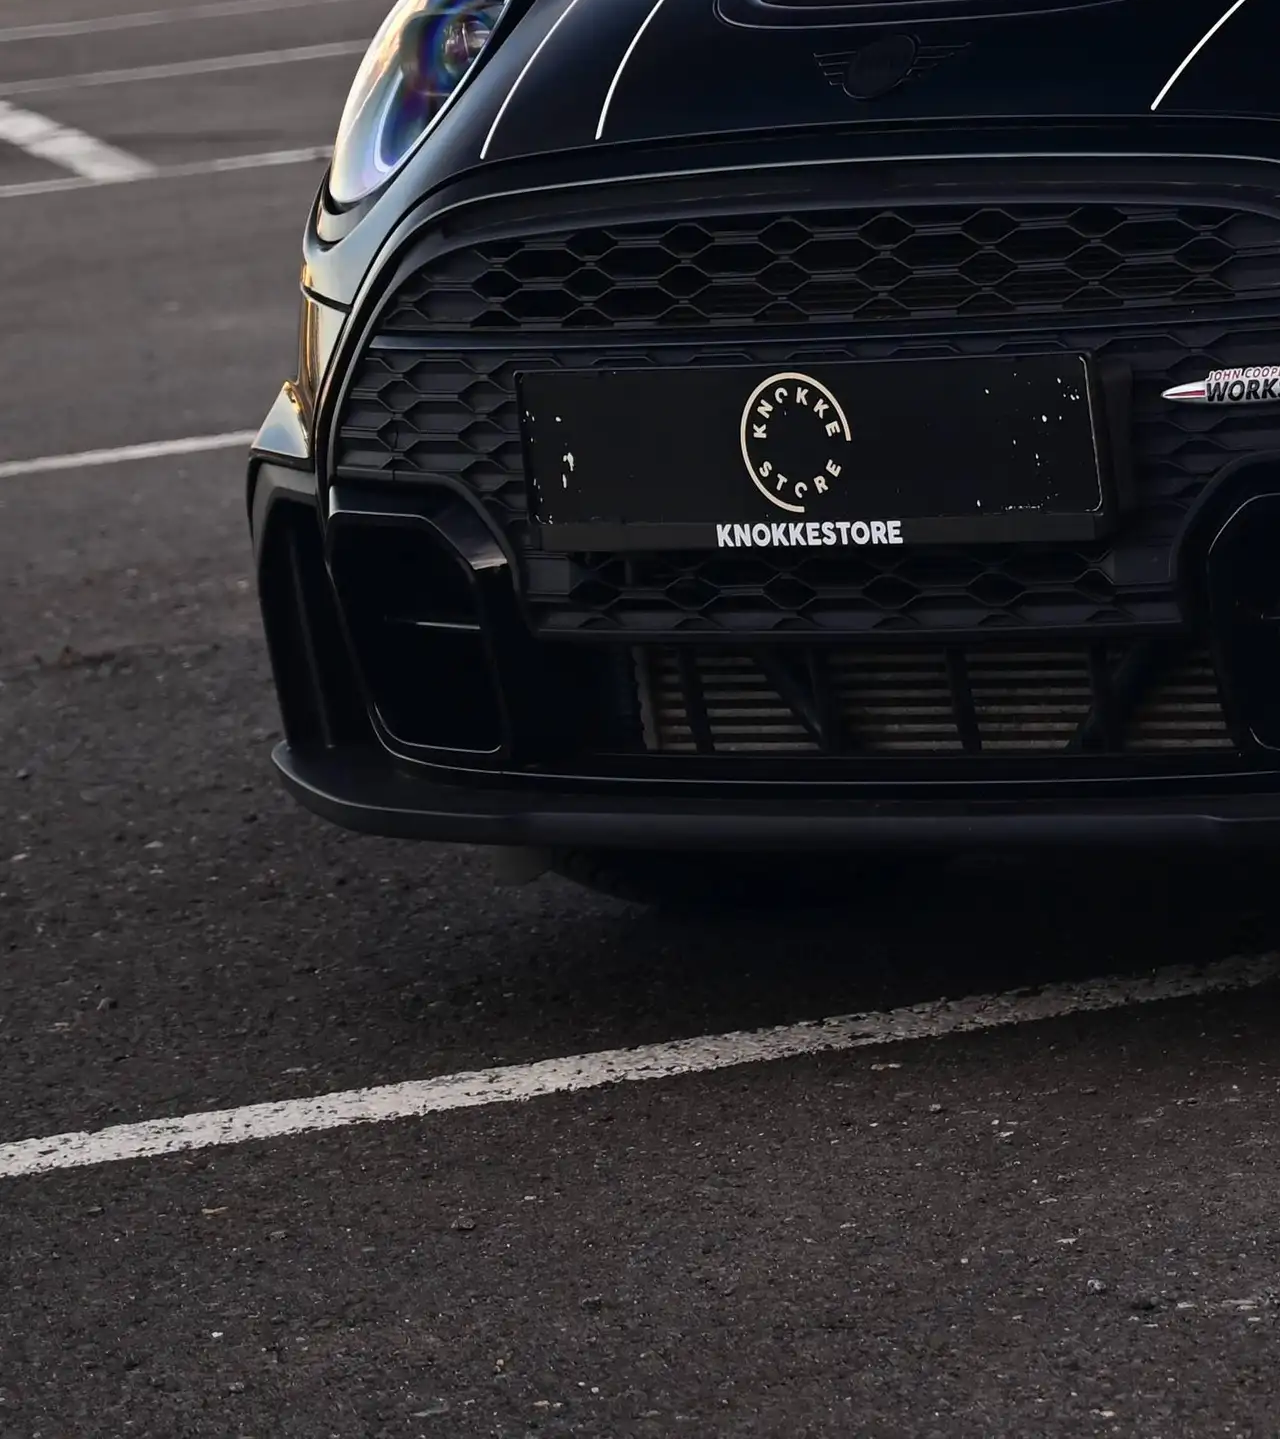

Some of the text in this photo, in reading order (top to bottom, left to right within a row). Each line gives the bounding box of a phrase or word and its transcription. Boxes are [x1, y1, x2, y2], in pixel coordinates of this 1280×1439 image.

[1207, 369, 1241, 381] JOHN
[753, 387, 841, 439] KNOKKE
[759, 459, 842, 498] STORE
[716, 520, 903, 547] KNOKKESTORE
